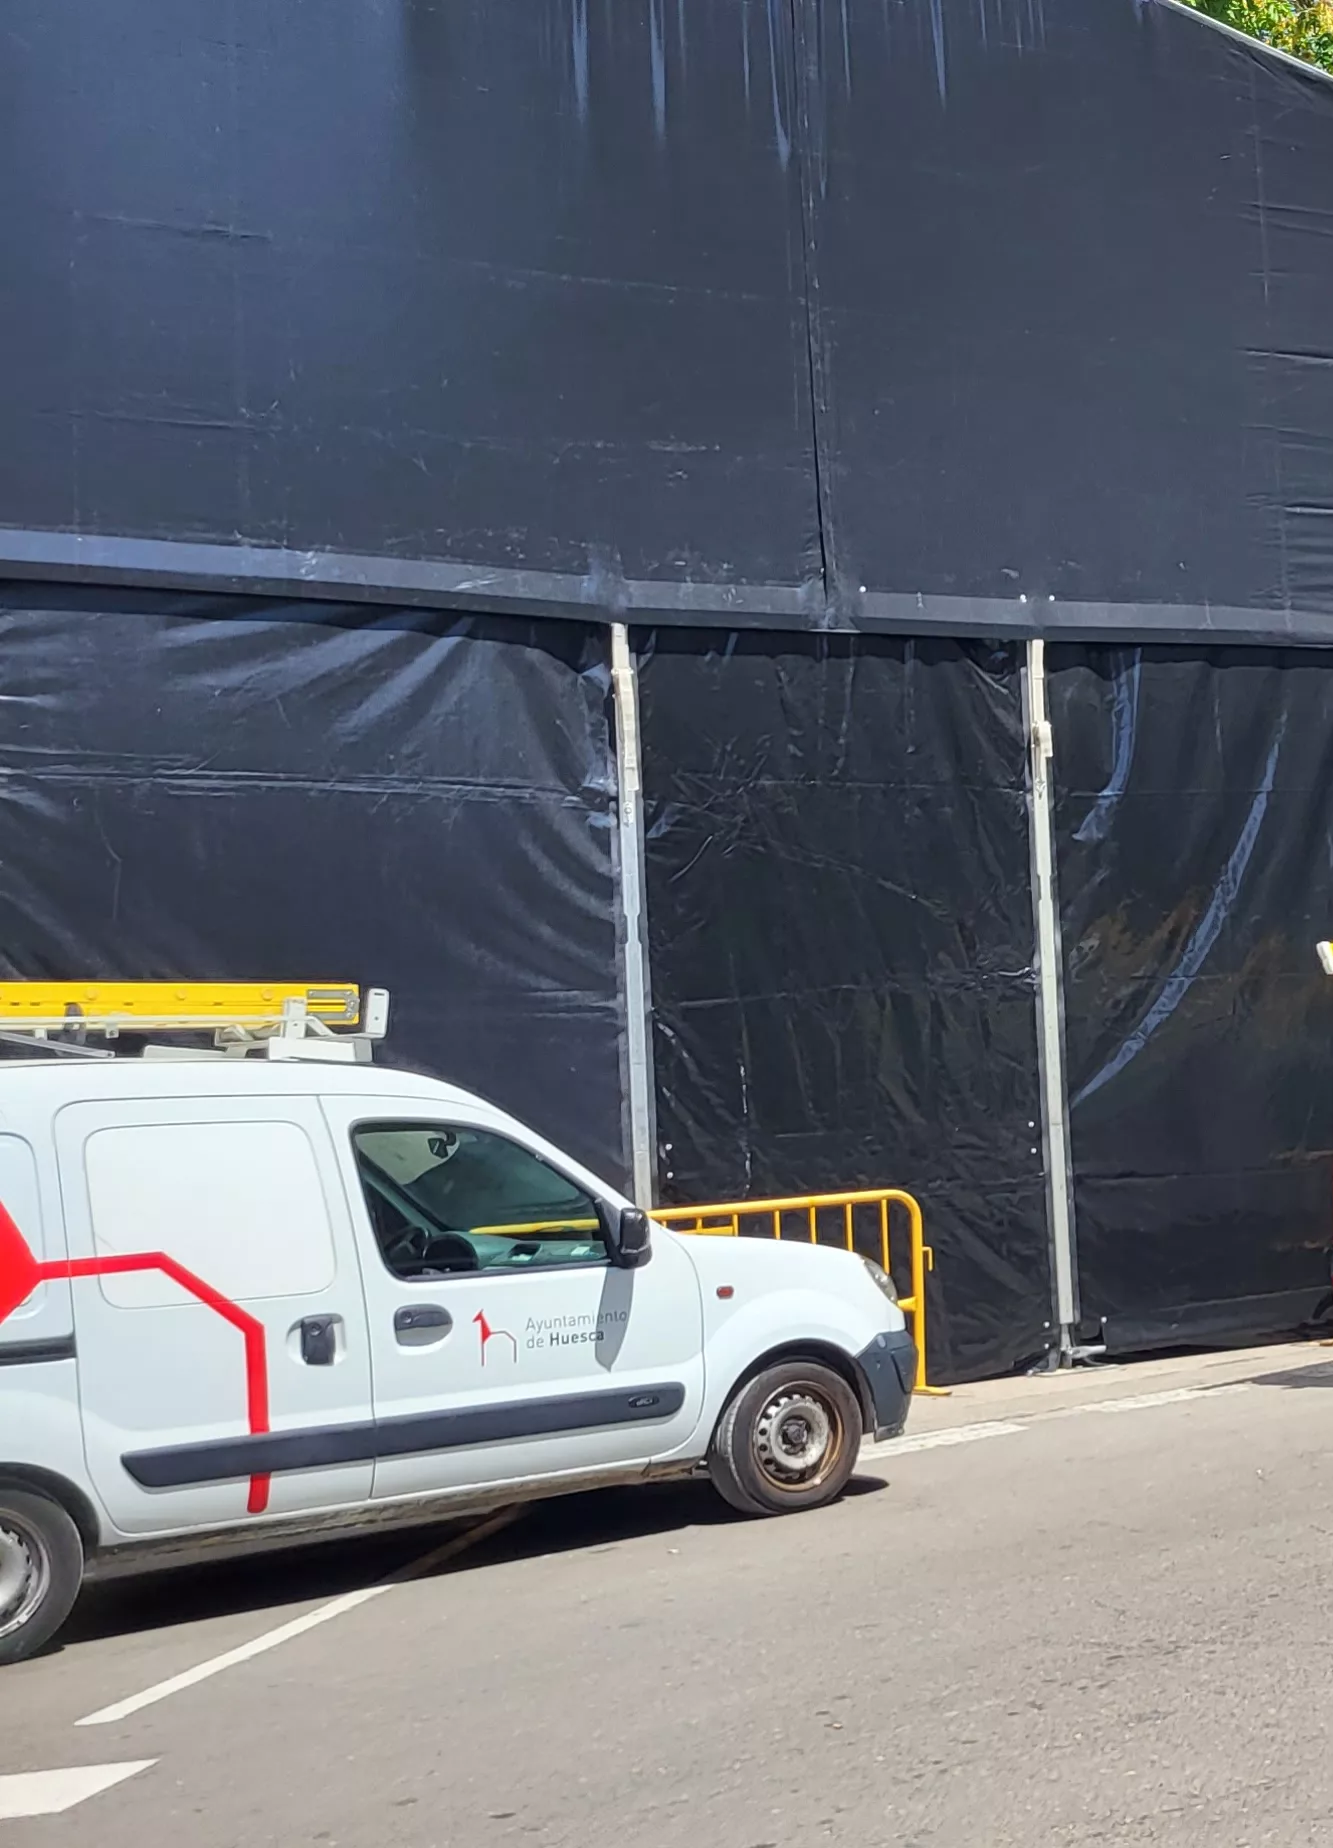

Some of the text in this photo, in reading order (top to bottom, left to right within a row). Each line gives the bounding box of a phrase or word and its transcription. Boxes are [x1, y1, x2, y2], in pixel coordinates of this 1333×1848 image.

[525, 1309, 628, 1333] Ayuntamiento
[526, 1330, 605, 1349] de Huesca
